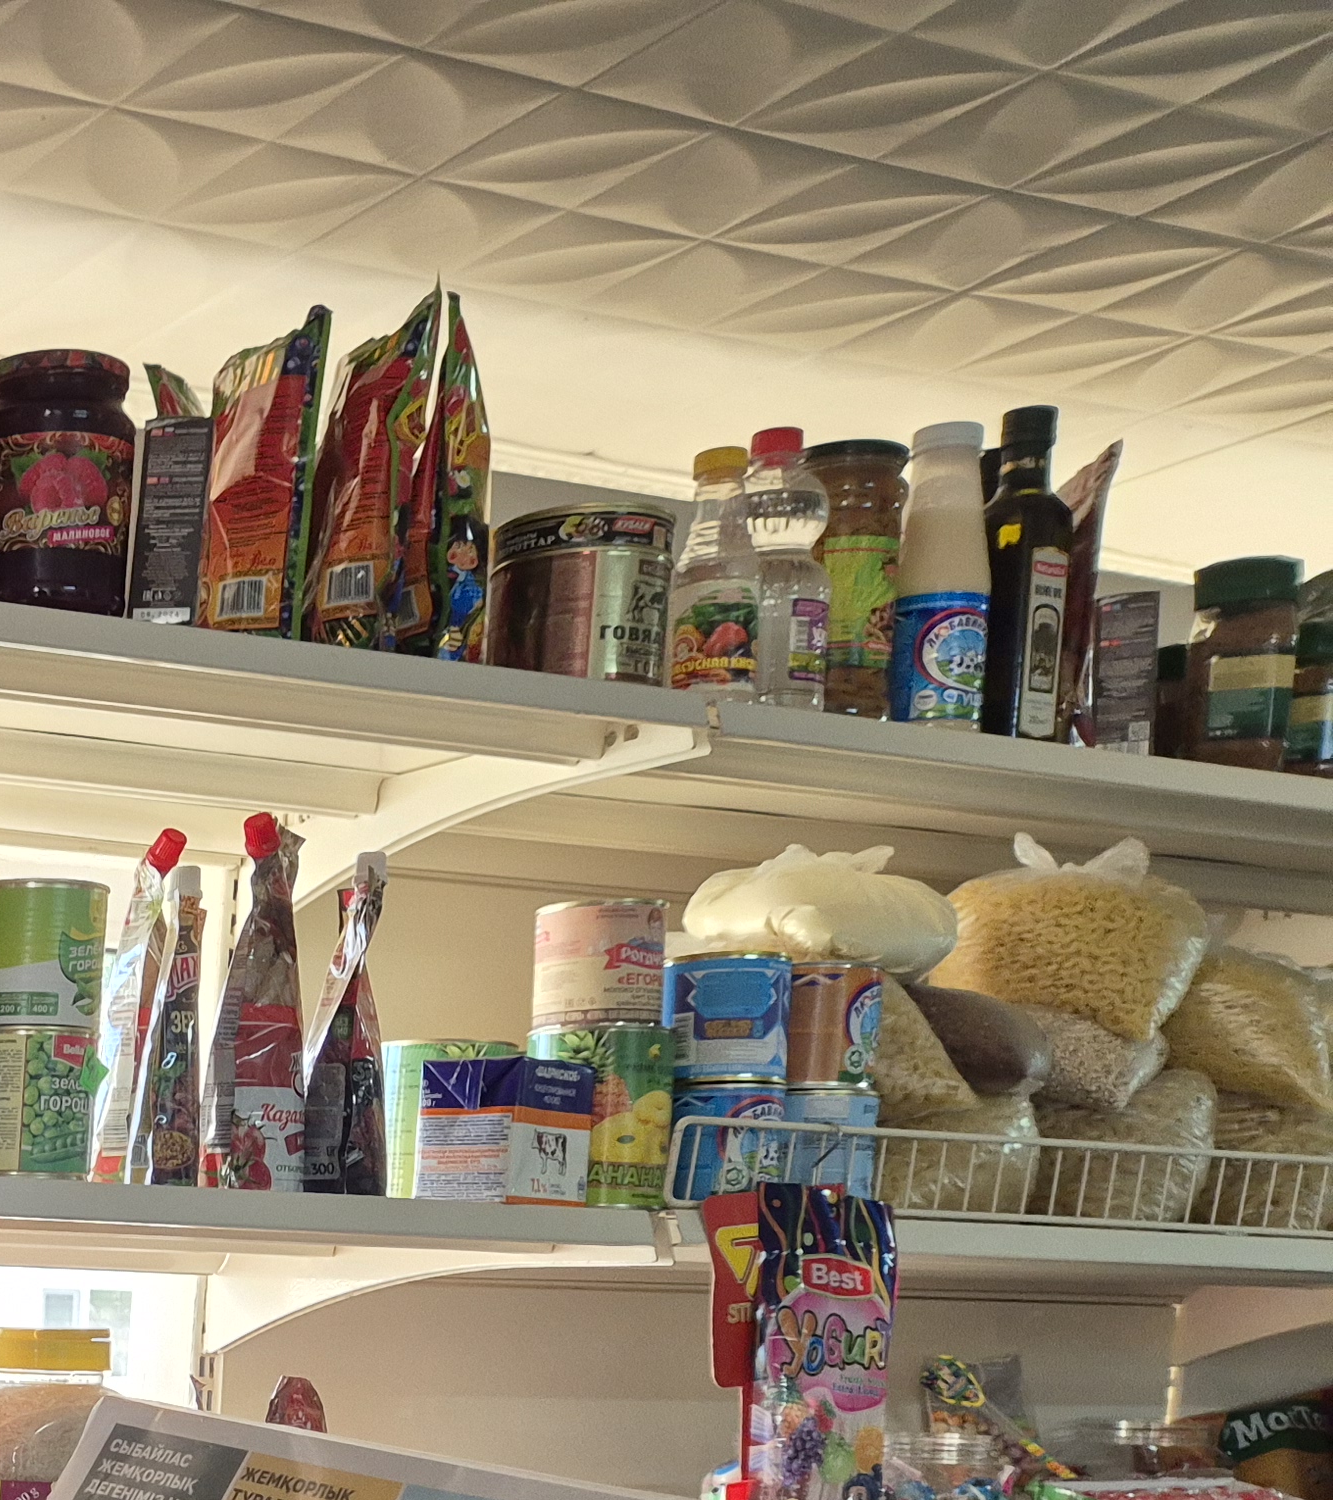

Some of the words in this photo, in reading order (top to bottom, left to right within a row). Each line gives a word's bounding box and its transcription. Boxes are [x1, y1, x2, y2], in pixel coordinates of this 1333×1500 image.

[2, 505, 101, 544] Варенье
[51, 528, 112, 544] МАЛИНОВОЕ
[0, 1003, 14, 1014] 200
[32, 1004, 48, 1015] 400
[310, 1162, 335, 1176] 300
[809, 1264, 866, 1293] Best
[110, 1439, 193, 1468] СЫБАЙЛАС
[98, 1459, 198, 1495] ЖЕМҚОРЛЫҚ
